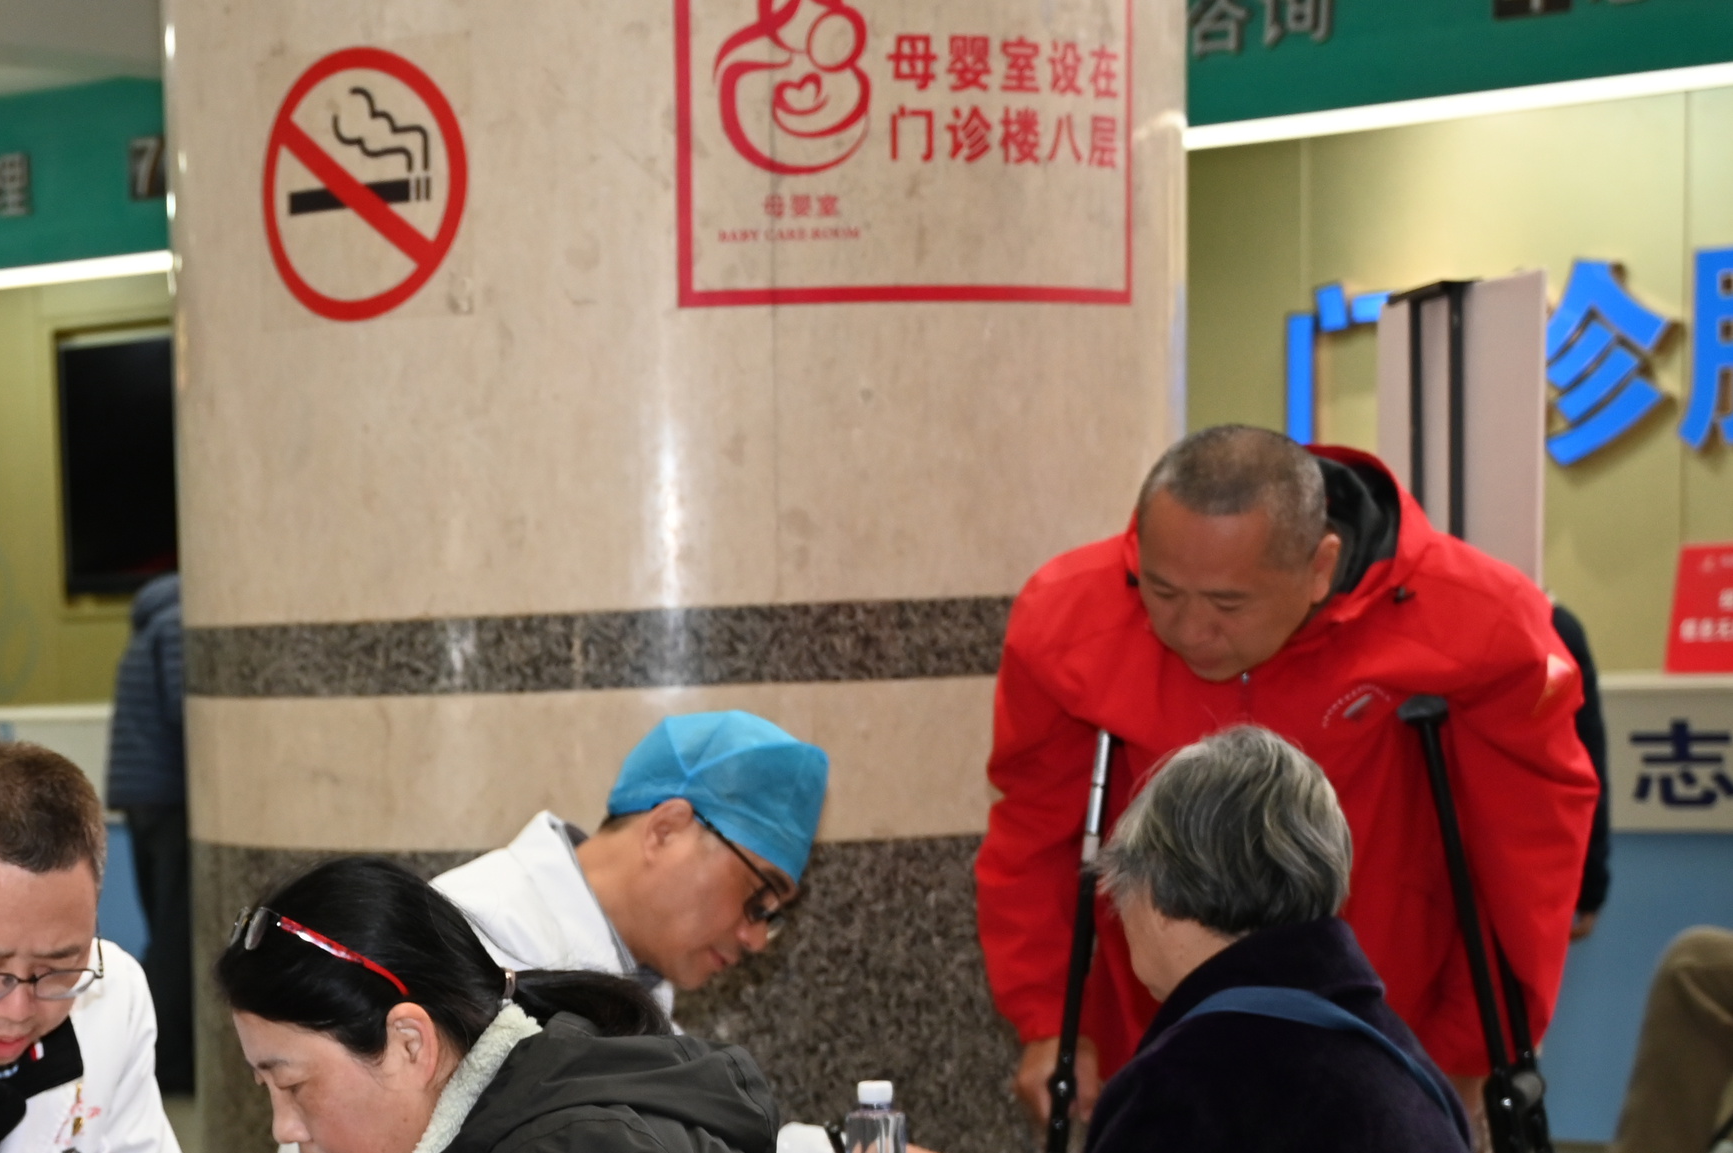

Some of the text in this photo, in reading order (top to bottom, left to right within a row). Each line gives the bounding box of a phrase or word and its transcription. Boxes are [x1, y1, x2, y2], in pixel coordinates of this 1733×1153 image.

[1191, 0, 1333, 57] 咨询
[887, 33, 1119, 99] 母婴室设在
[890, 105, 1118, 169] 门诊楼八层
[763, 194, 839, 219] 母婴室
[1629, 718, 1733, 809] 志
